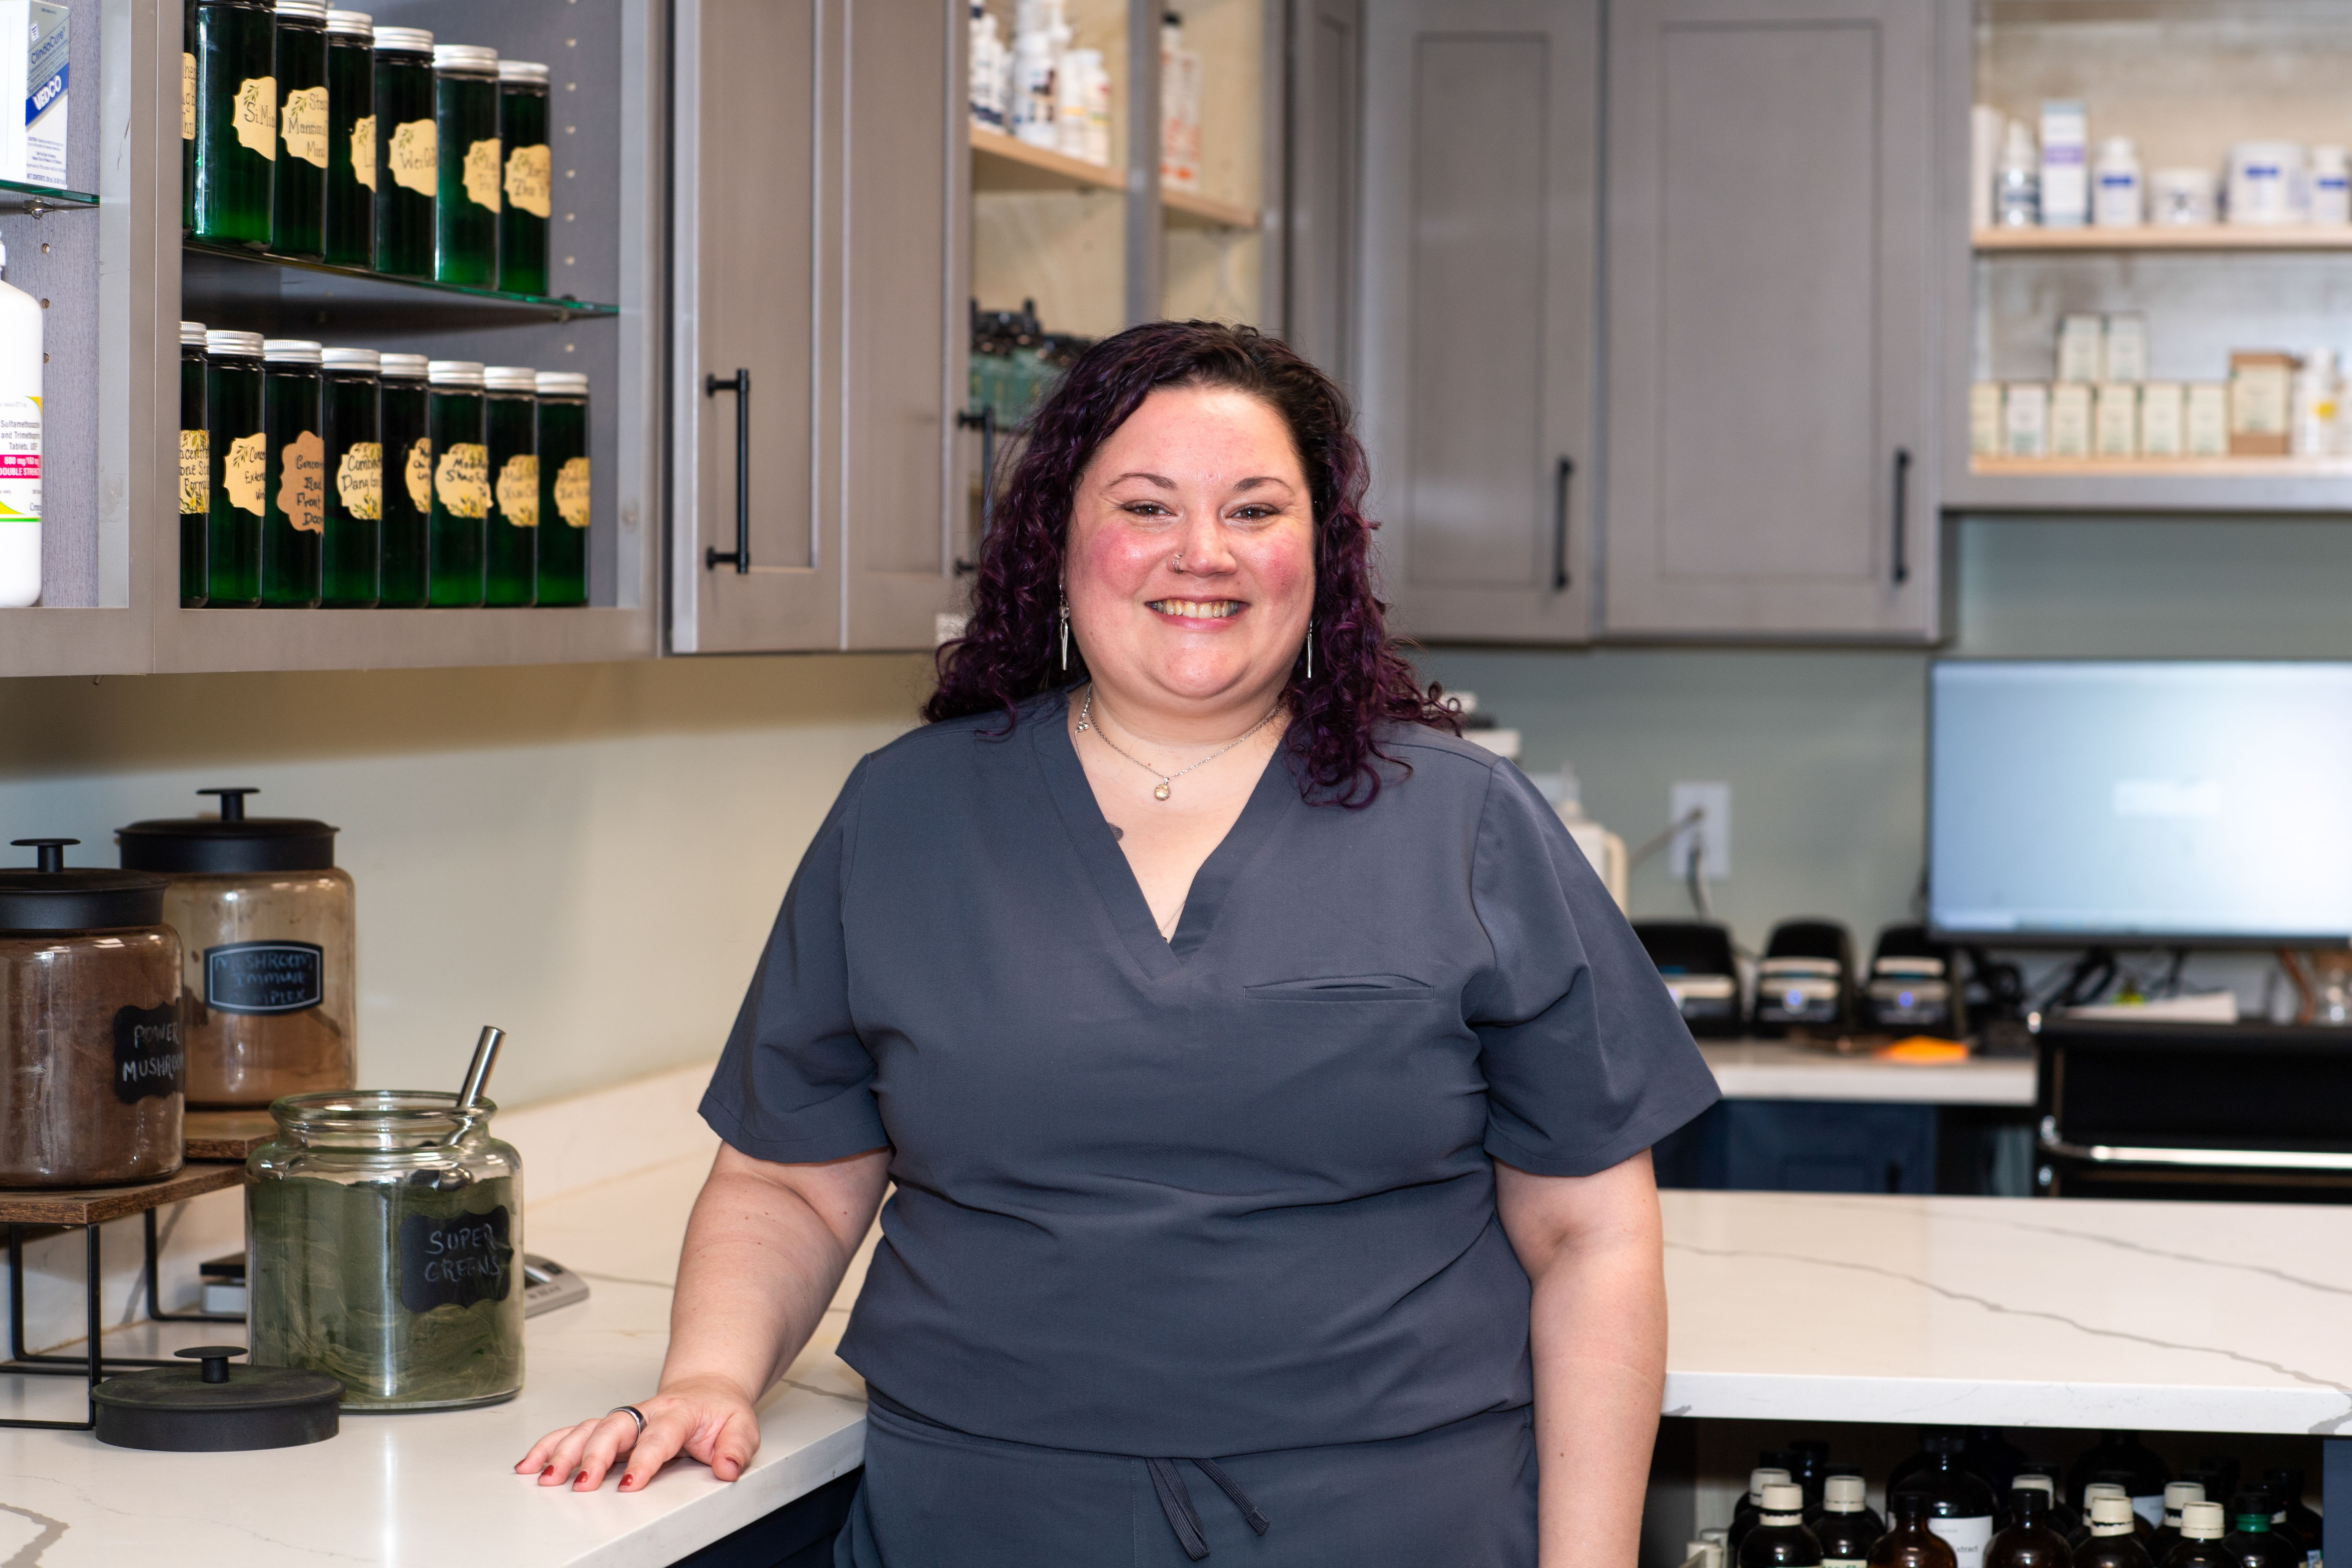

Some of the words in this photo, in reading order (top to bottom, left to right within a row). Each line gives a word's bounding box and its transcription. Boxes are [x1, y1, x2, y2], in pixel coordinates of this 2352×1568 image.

[33, 75, 62, 111] VEDCO
[4, 457, 16, 465] 800
[425, 1223, 497, 1255] SUPER
